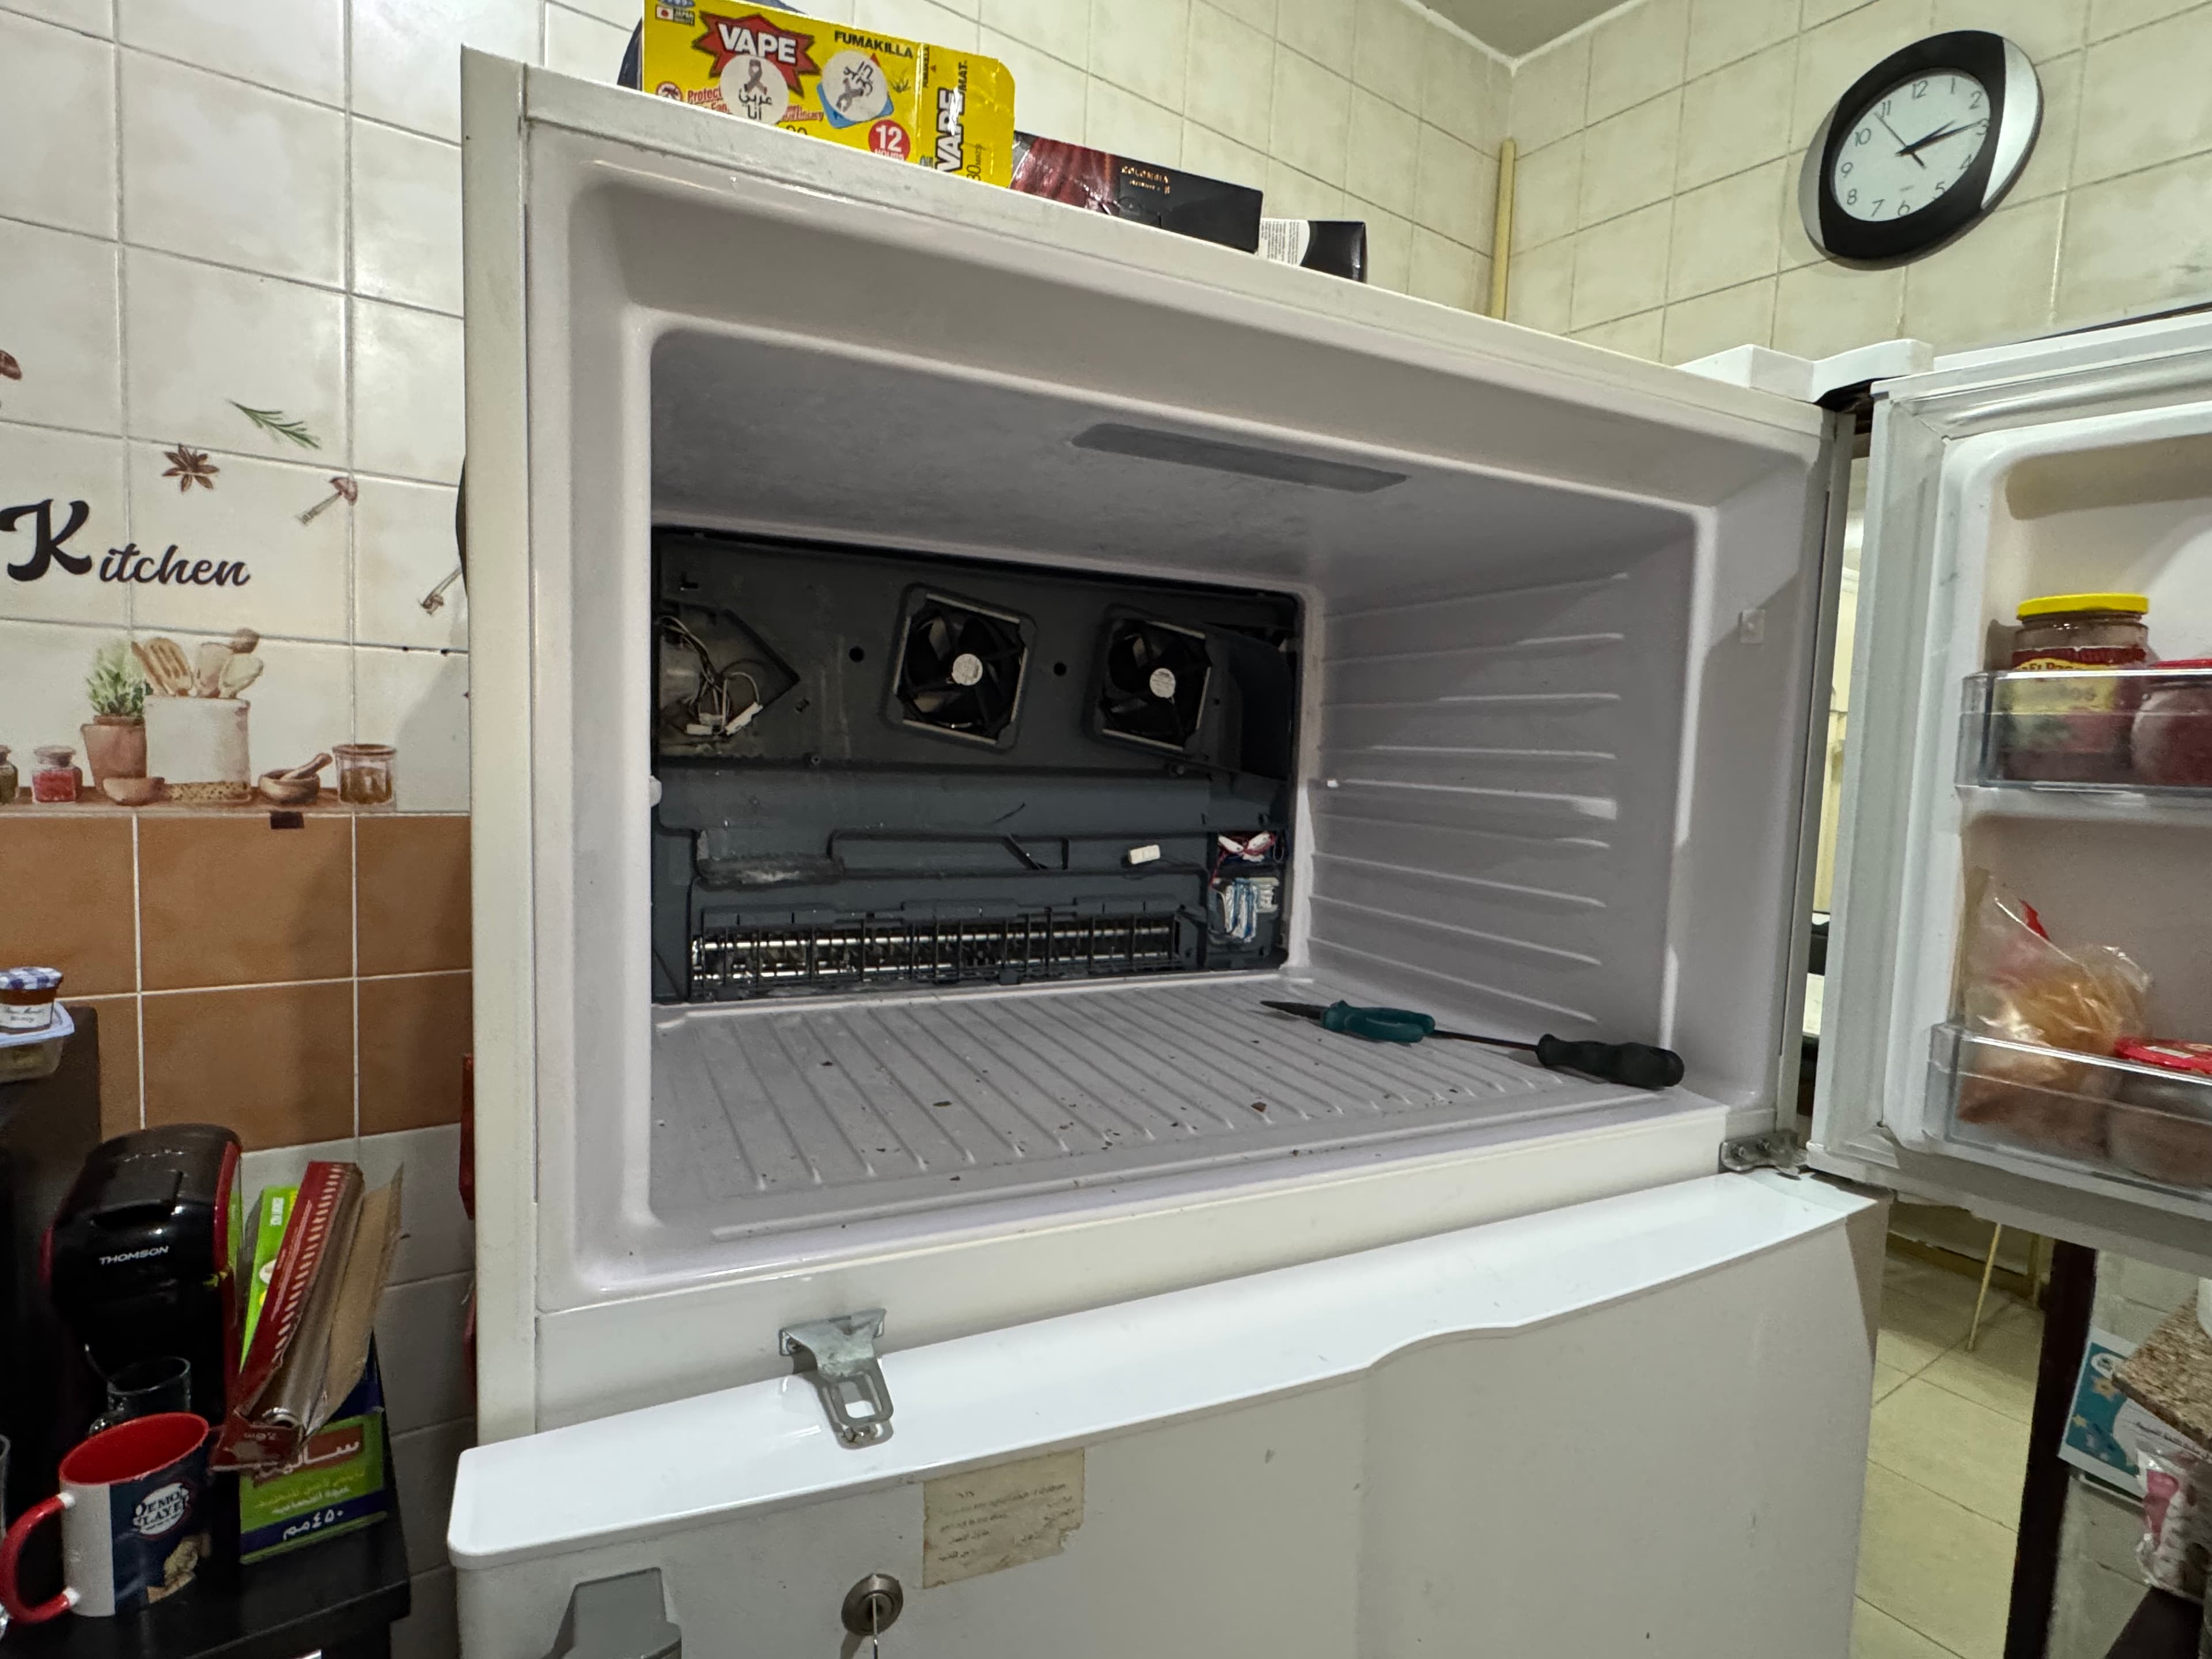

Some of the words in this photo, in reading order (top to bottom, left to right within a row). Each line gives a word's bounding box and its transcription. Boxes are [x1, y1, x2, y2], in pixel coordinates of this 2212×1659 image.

[718, 23, 797, 65] VAPE
[834, 31, 914, 59] FUMAKILLA
[1912, 79, 1928, 100] 12
[1949, 77, 1956, 94] 1
[1968, 90, 1982, 109] 2
[1880, 100, 1892, 120] 11
[935, 86, 965, 173] VAPE
[1976, 118, 1989, 135] 3
[875, 125, 903, 153] 12
[1854, 127, 1872, 147] 10
[1841, 162, 1854, 177] 9
[1959, 154, 1973, 170] 4
[1847, 188, 1858, 205] 8
[1932, 181, 1945, 199] 5
[1871, 199, 1885, 217] 7
[1897, 200, 1911, 217] 6
[0, 498, 251, 586] Kitchen
[99, 1244, 170, 1266] THOMSON
